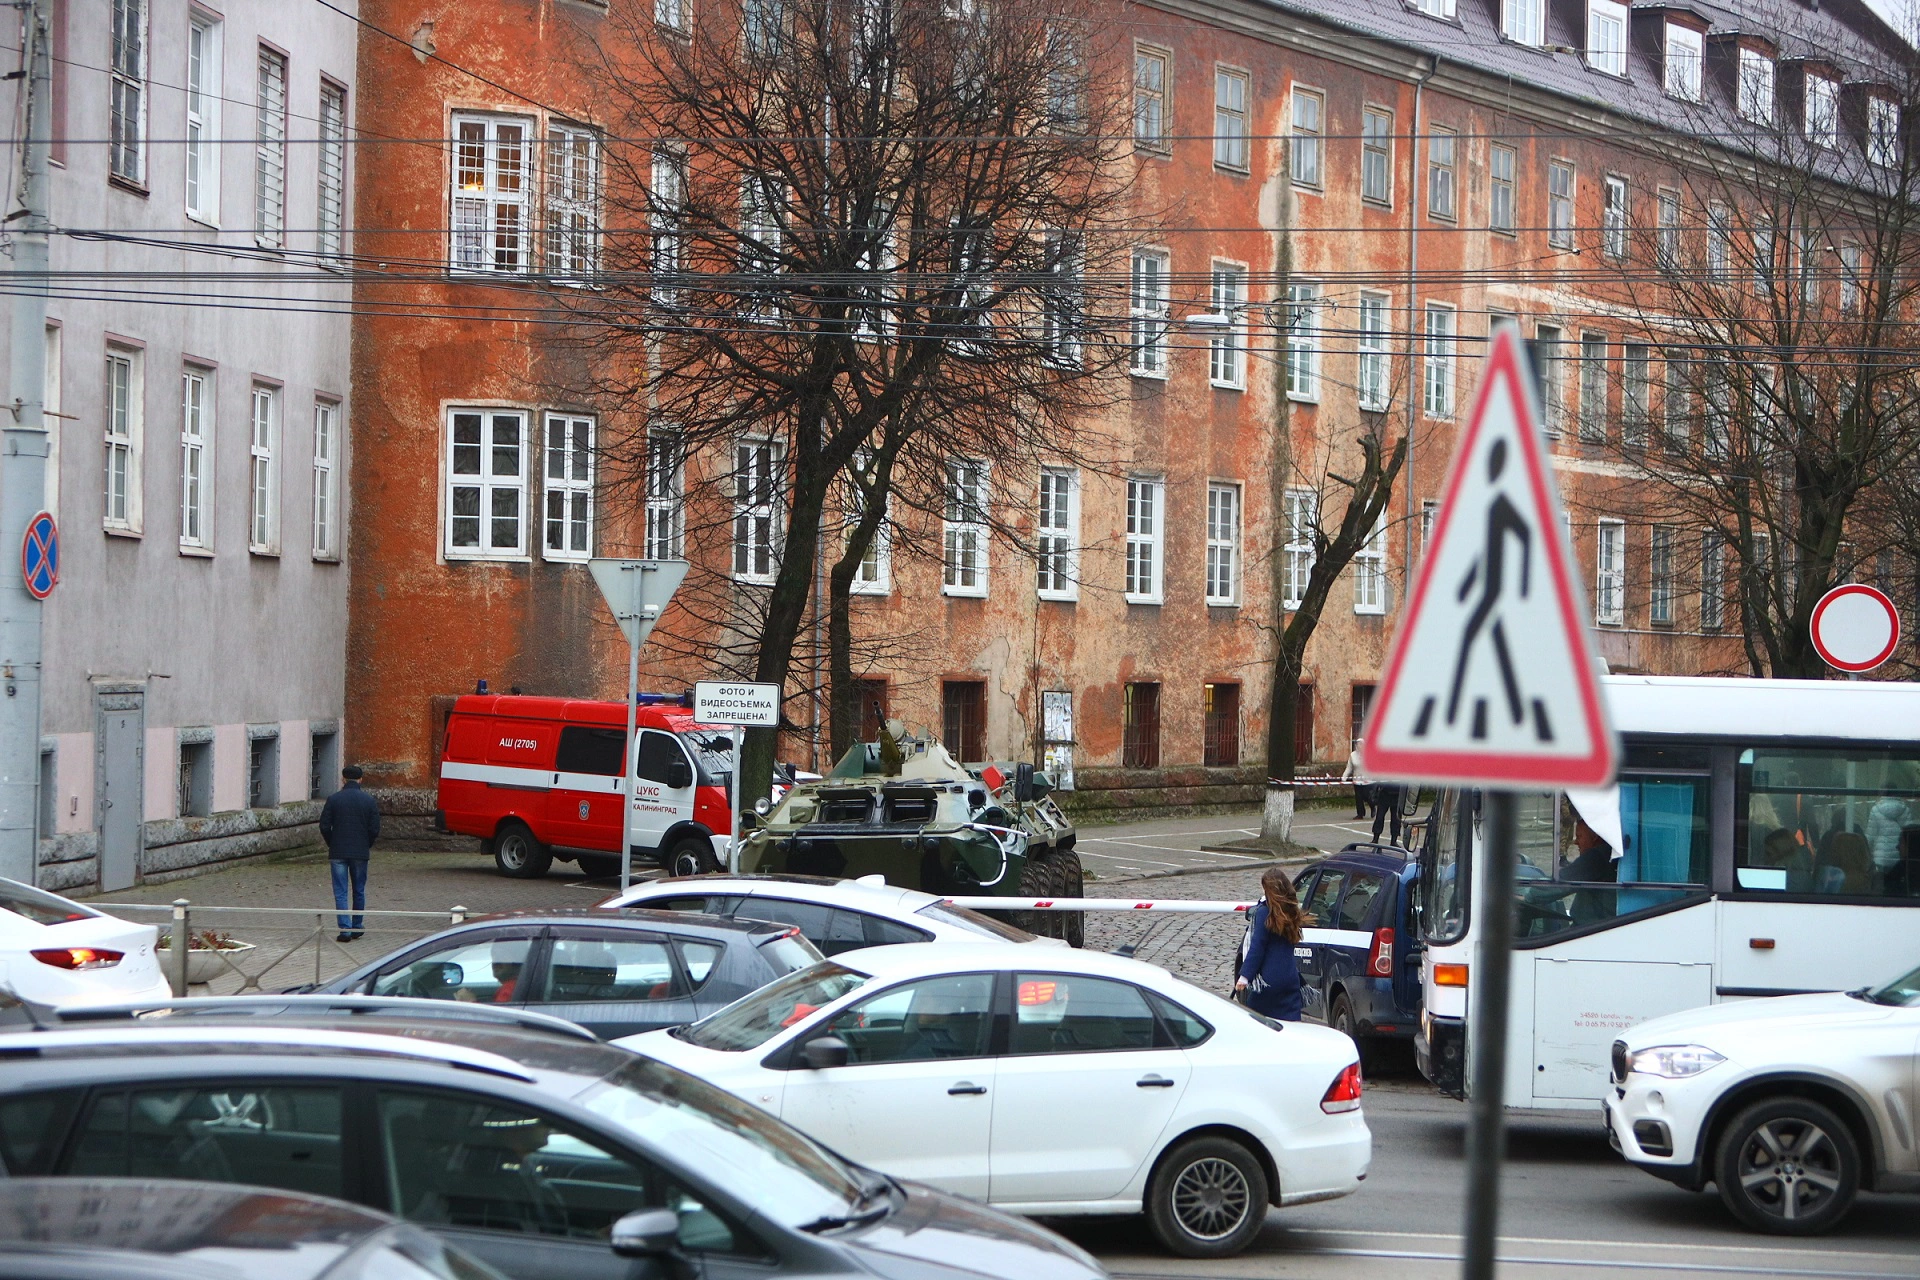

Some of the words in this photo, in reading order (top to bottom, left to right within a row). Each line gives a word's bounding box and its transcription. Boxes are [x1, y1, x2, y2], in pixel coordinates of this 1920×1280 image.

[719, 688, 746, 696] ФОТО
[700, 699, 772, 709] ВИДЕОСЪЕМКА
[707, 711, 768, 720] ЗАПРЕЩЕНА!
[499, 738, 514, 747] АШ
[514, 739, 537, 751] (2705)
[636, 786, 660, 796] ЦУКС
[633, 804, 677, 815] КАЛИНИНГРАД
